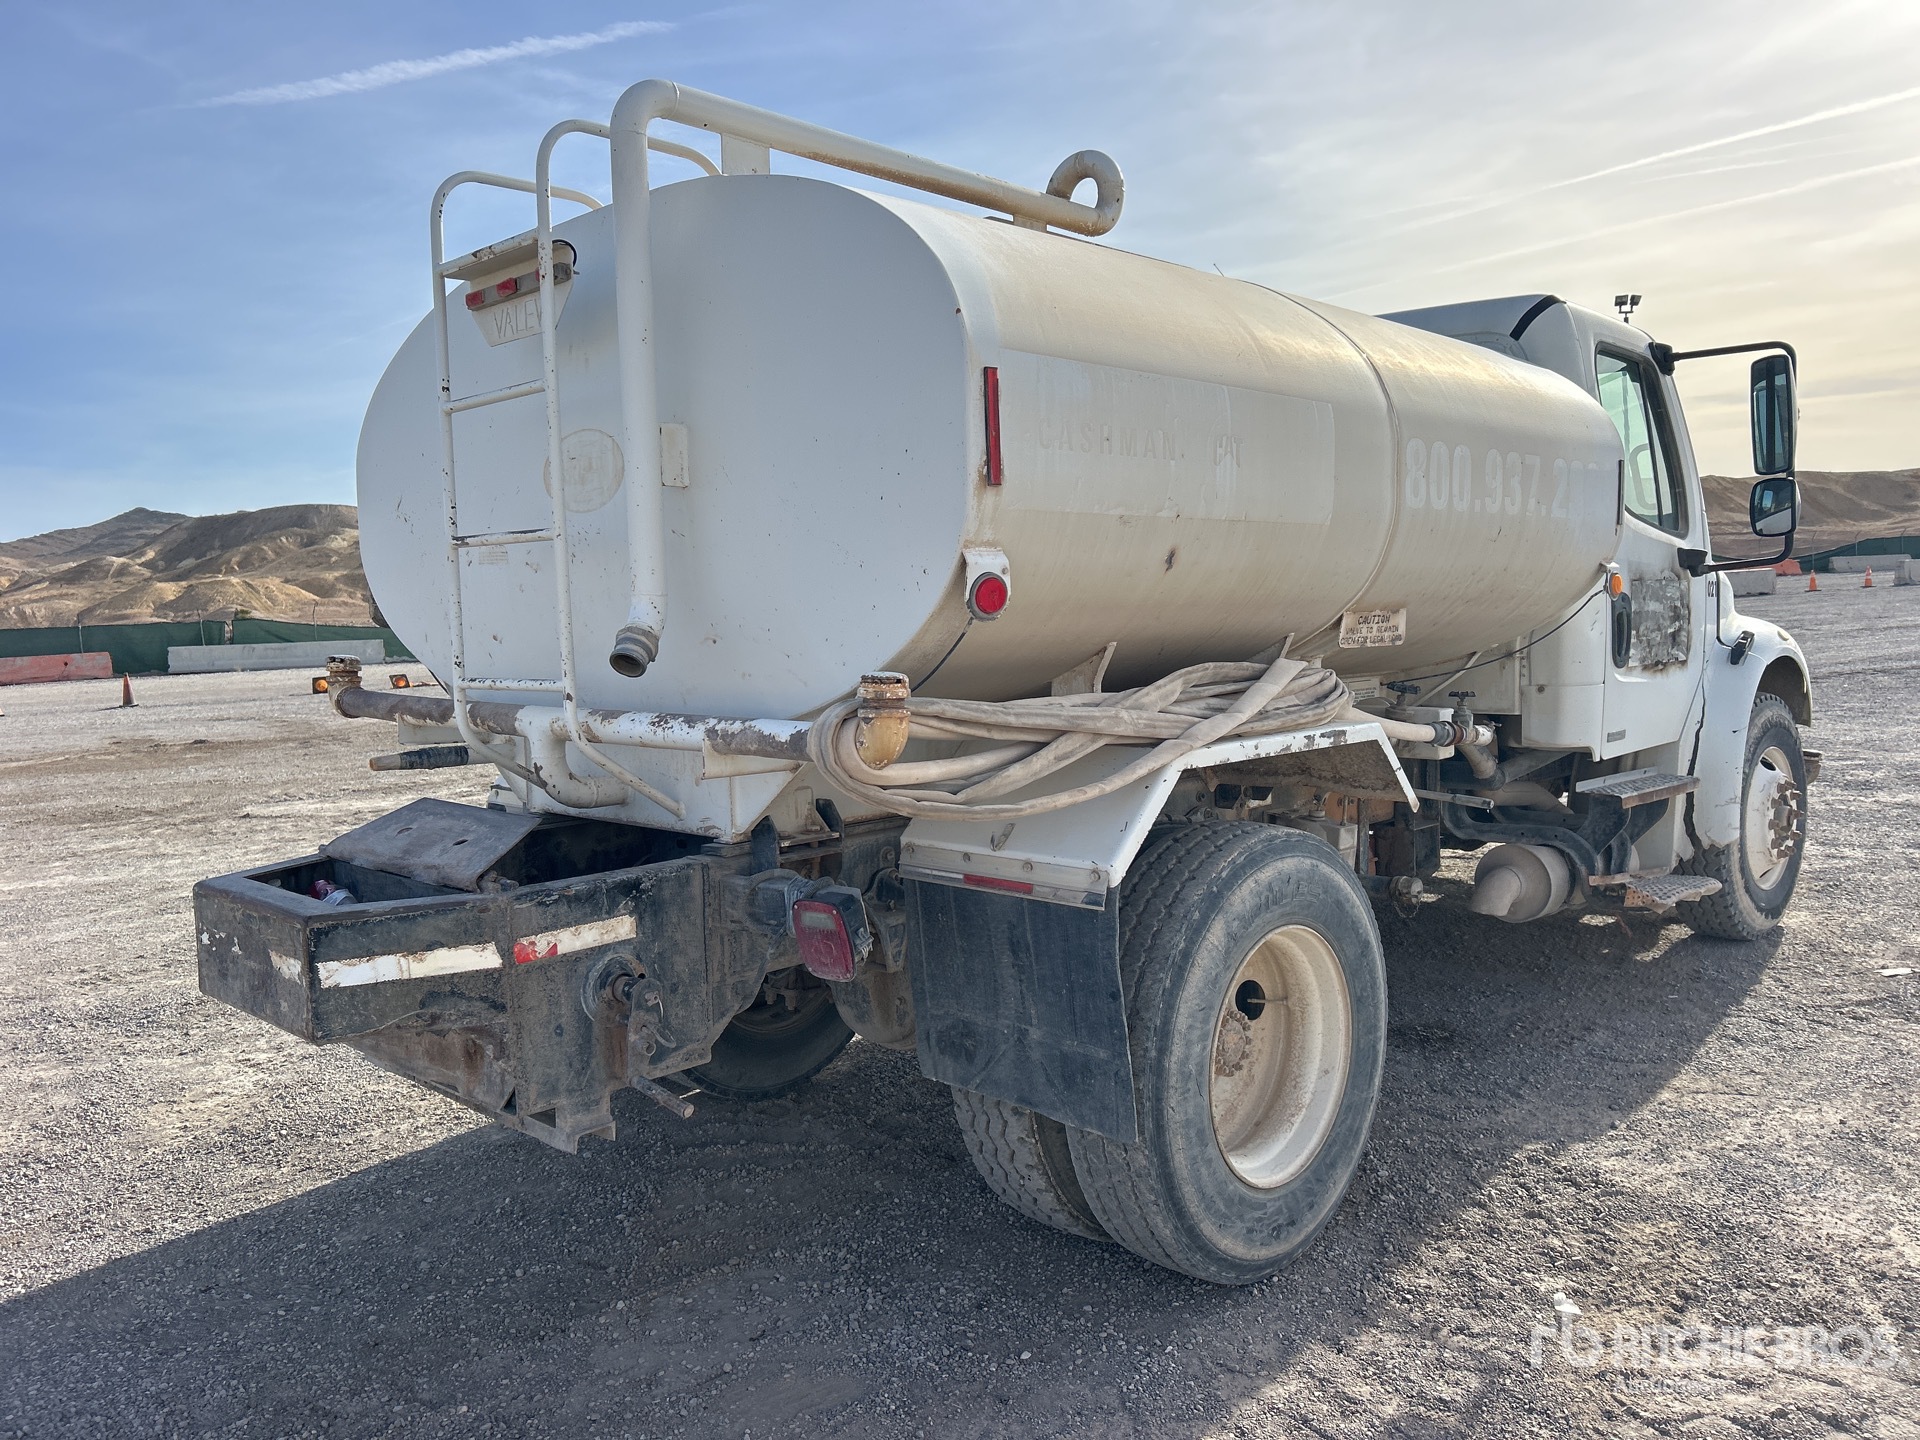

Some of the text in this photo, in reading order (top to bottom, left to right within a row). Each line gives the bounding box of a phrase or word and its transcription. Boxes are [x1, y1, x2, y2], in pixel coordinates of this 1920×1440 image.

[1038, 416, 1177, 461] CASHMAN
[1357, 614, 1391, 626] CAUTION
[1366, 626, 1374, 635] TO
[1376, 624, 1399, 634] REMAIN
